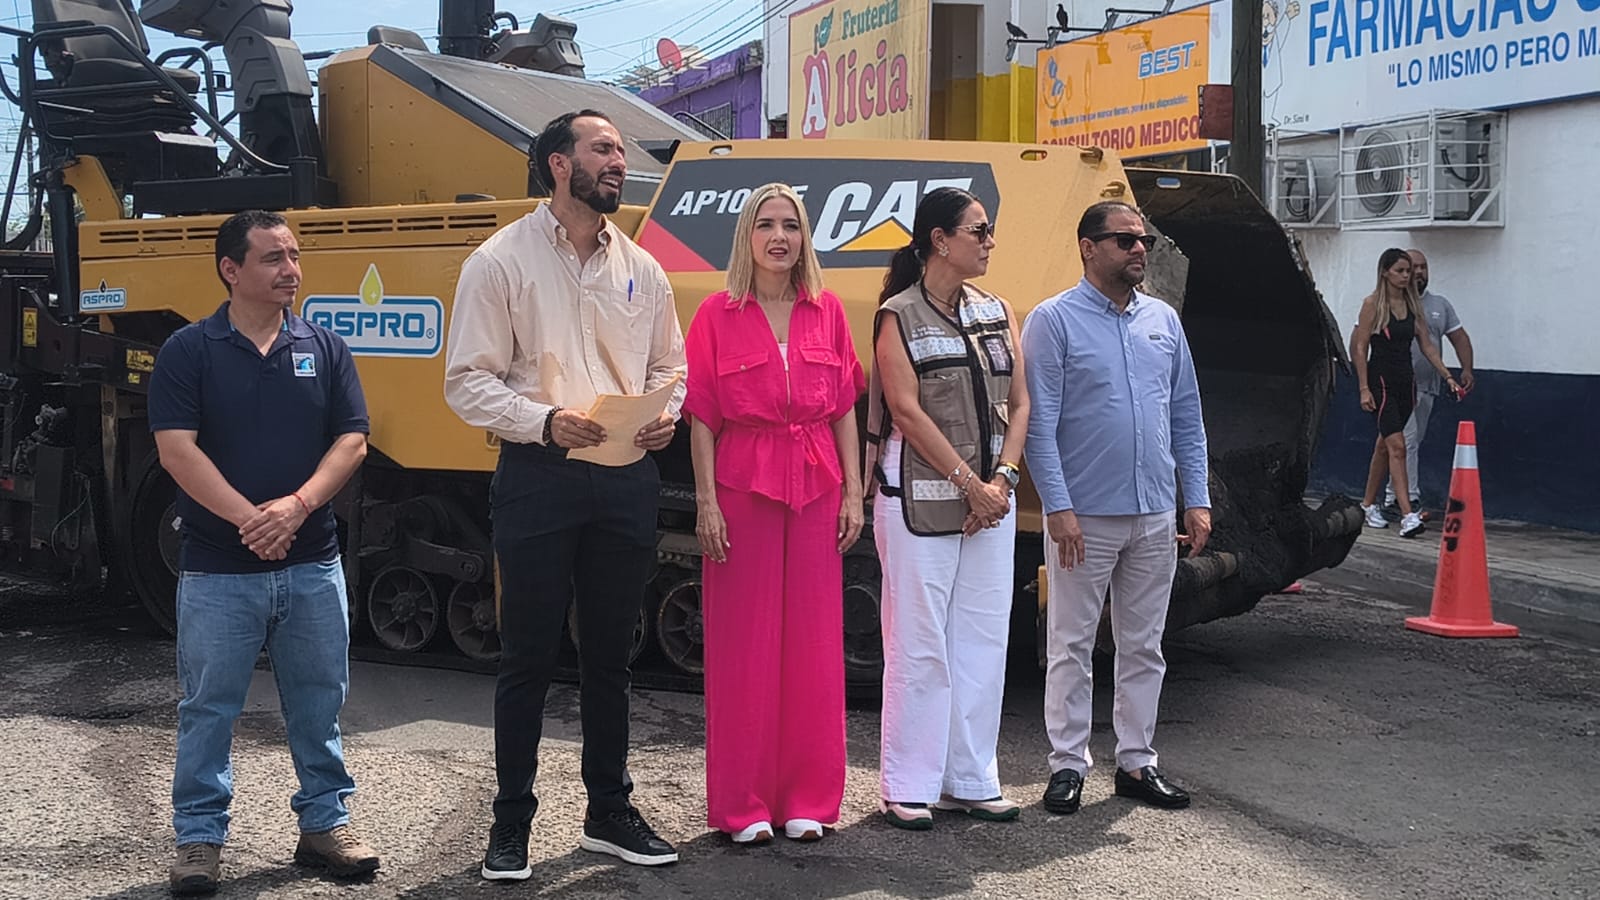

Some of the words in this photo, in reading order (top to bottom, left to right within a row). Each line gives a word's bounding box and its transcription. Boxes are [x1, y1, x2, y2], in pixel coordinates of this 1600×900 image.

[1138, 41, 1197, 79] BEST
[1388, 59, 1422, 88] "LO
[1429, 44, 1498, 82] MISMO
[1505, 32, 1570, 69] PERO
[1578, 27, 1600, 58] M
[803, 39, 909, 135] Alicia
[1042, 126, 1136, 150] LTORIO
[1140, 115, 1200, 146] MEDICO
[670, 185, 808, 216] AP10
[83, 294, 120, 305] ASPRO
[312, 311, 425, 338] ASPRO
